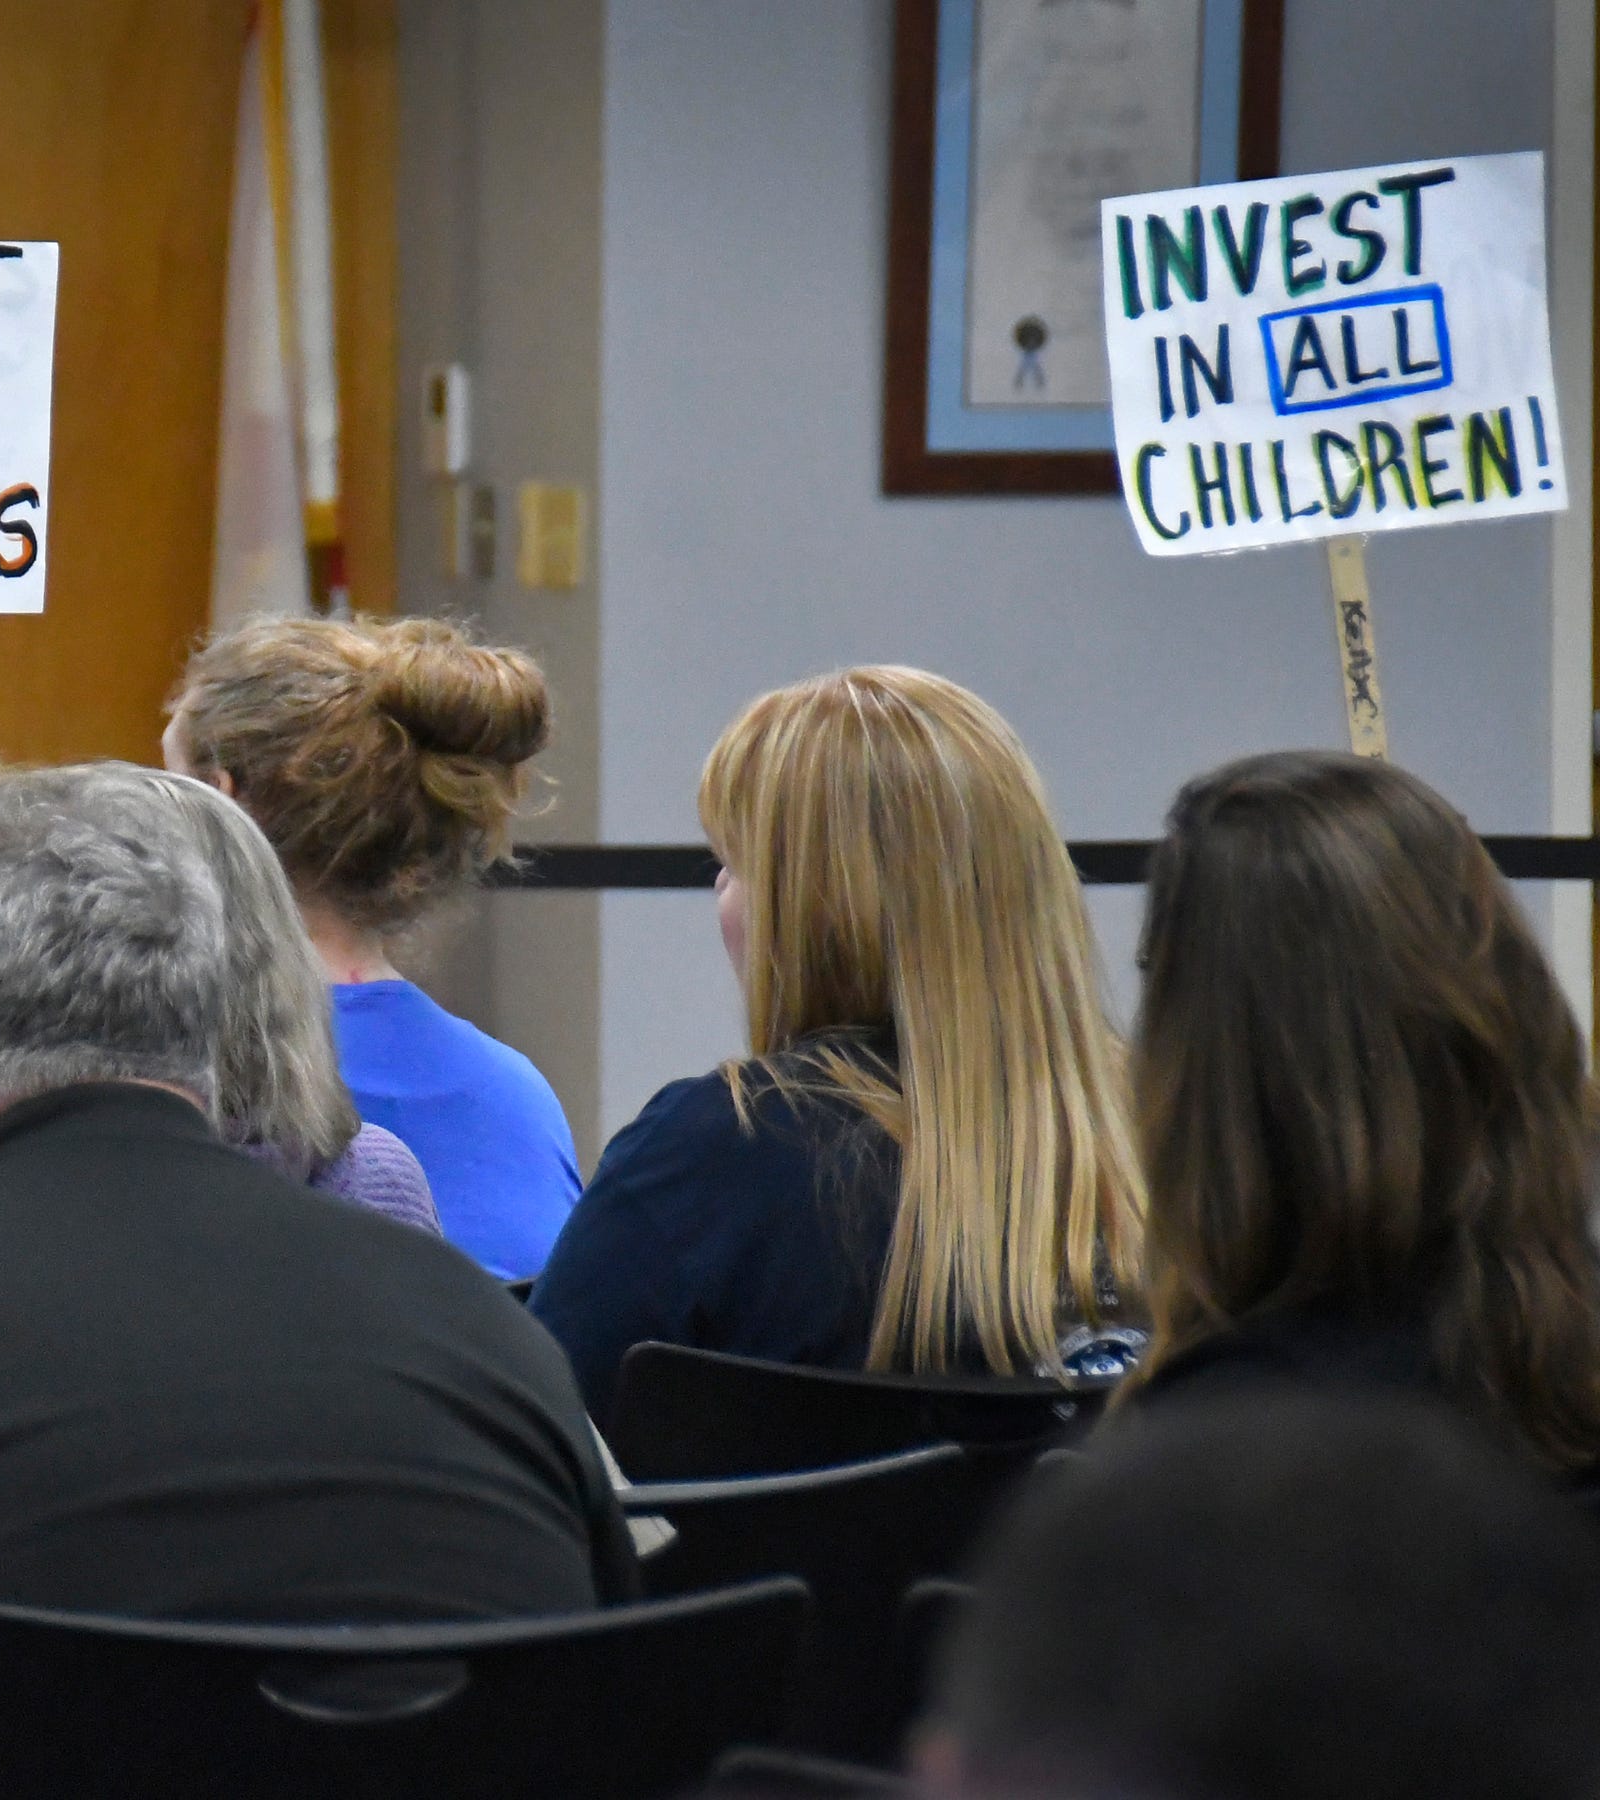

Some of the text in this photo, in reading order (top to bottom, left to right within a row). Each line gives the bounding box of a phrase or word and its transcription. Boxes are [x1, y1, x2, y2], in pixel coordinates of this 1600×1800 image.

[1115, 166, 1455, 320] INVEST
[1154, 308, 1442, 423] IN ALL
[1133, 395, 1555, 540] CHILDREN!
